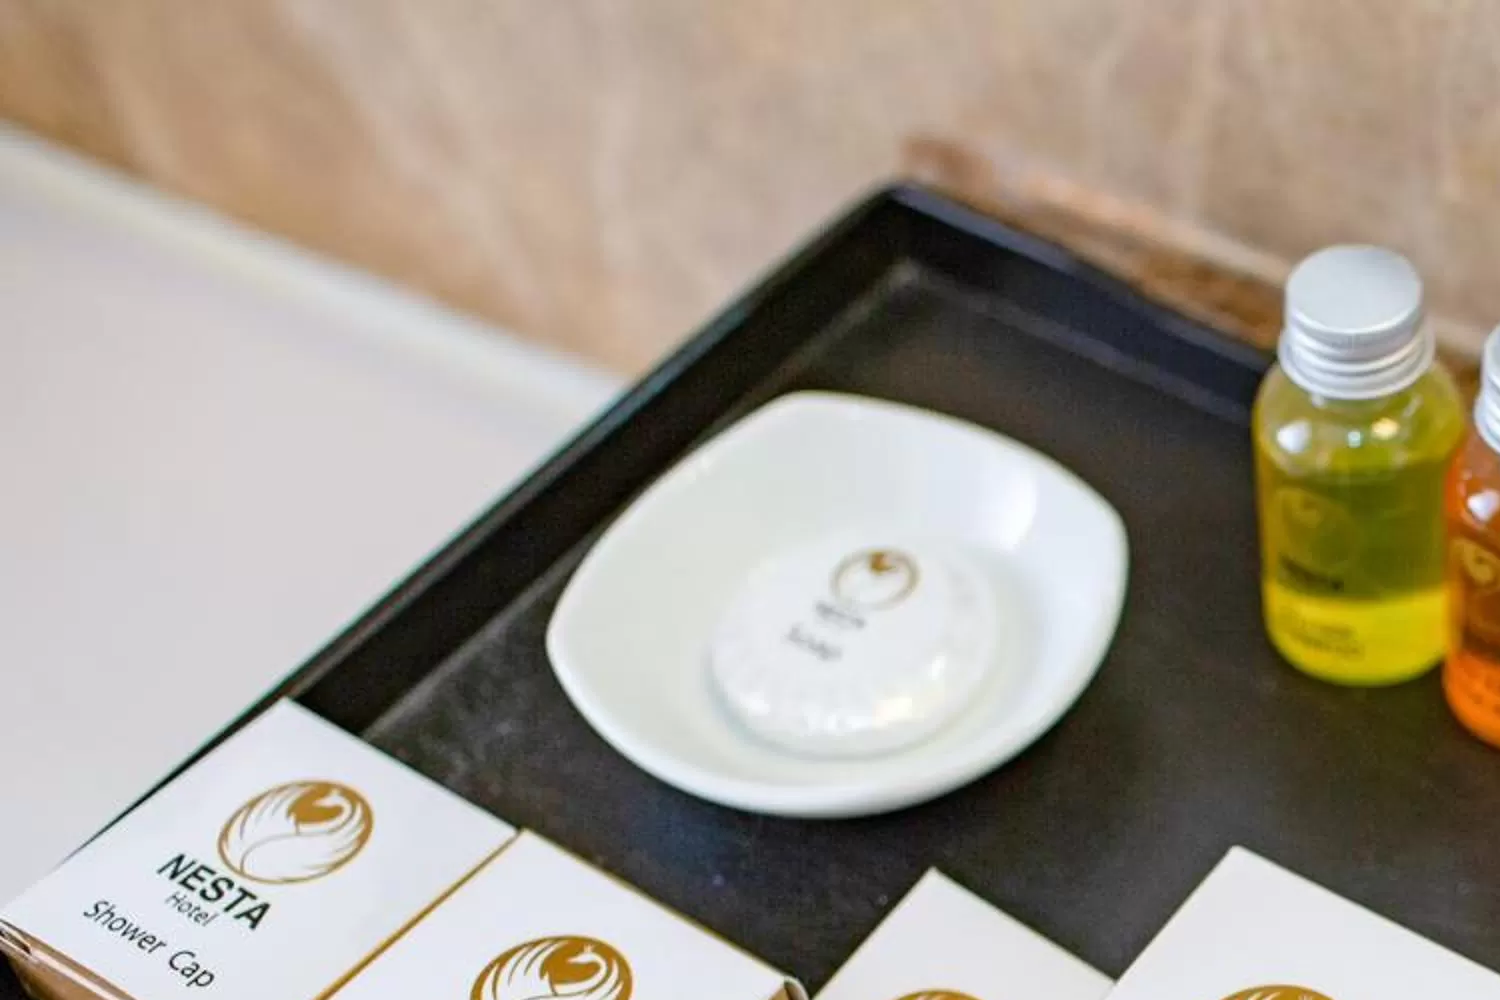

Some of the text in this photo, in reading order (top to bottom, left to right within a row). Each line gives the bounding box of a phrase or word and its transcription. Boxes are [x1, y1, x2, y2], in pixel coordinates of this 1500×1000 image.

[157, 853, 272, 930] NESTA
[165, 891, 219, 927] Hotel
[83, 900, 215, 990] Shower Cap
